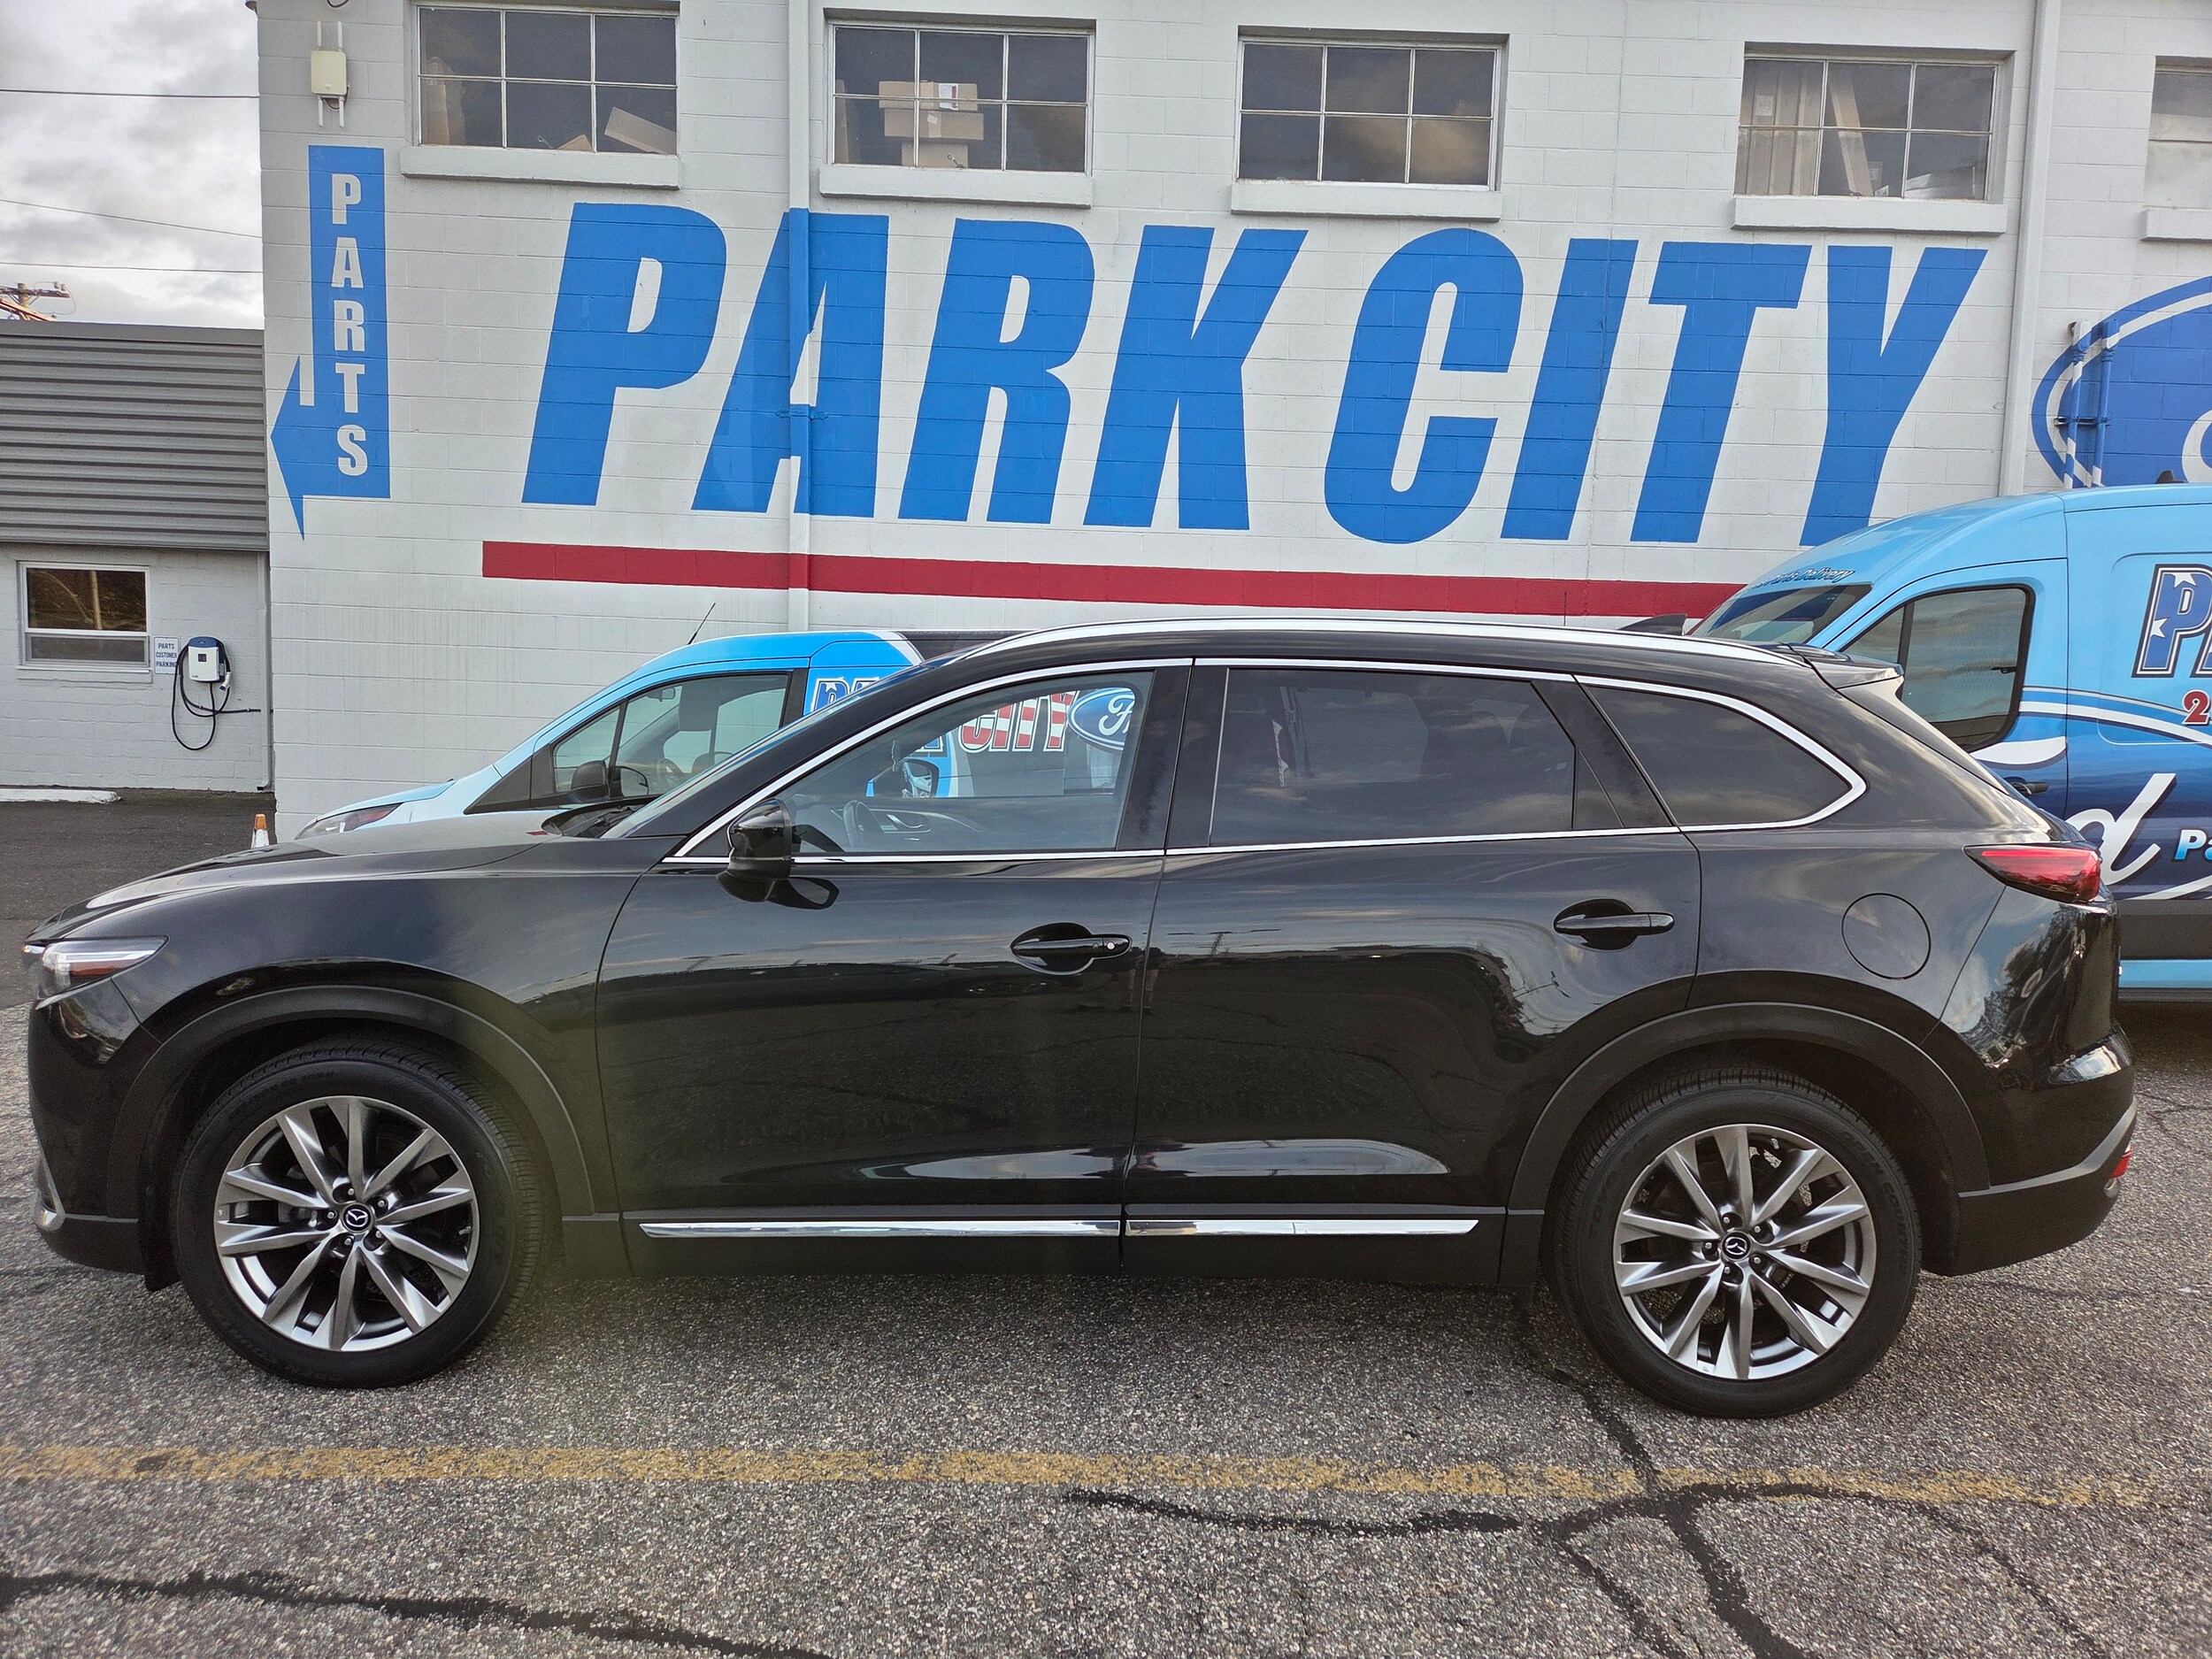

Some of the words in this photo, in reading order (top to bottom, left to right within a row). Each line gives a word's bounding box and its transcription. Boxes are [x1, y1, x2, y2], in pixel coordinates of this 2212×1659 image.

[330, 173, 369, 477] PARTS
[521, 203, 1309, 530] PARK
[1324, 227, 1988, 548] CITY
[1793, 567, 1856, 584] Delivery
